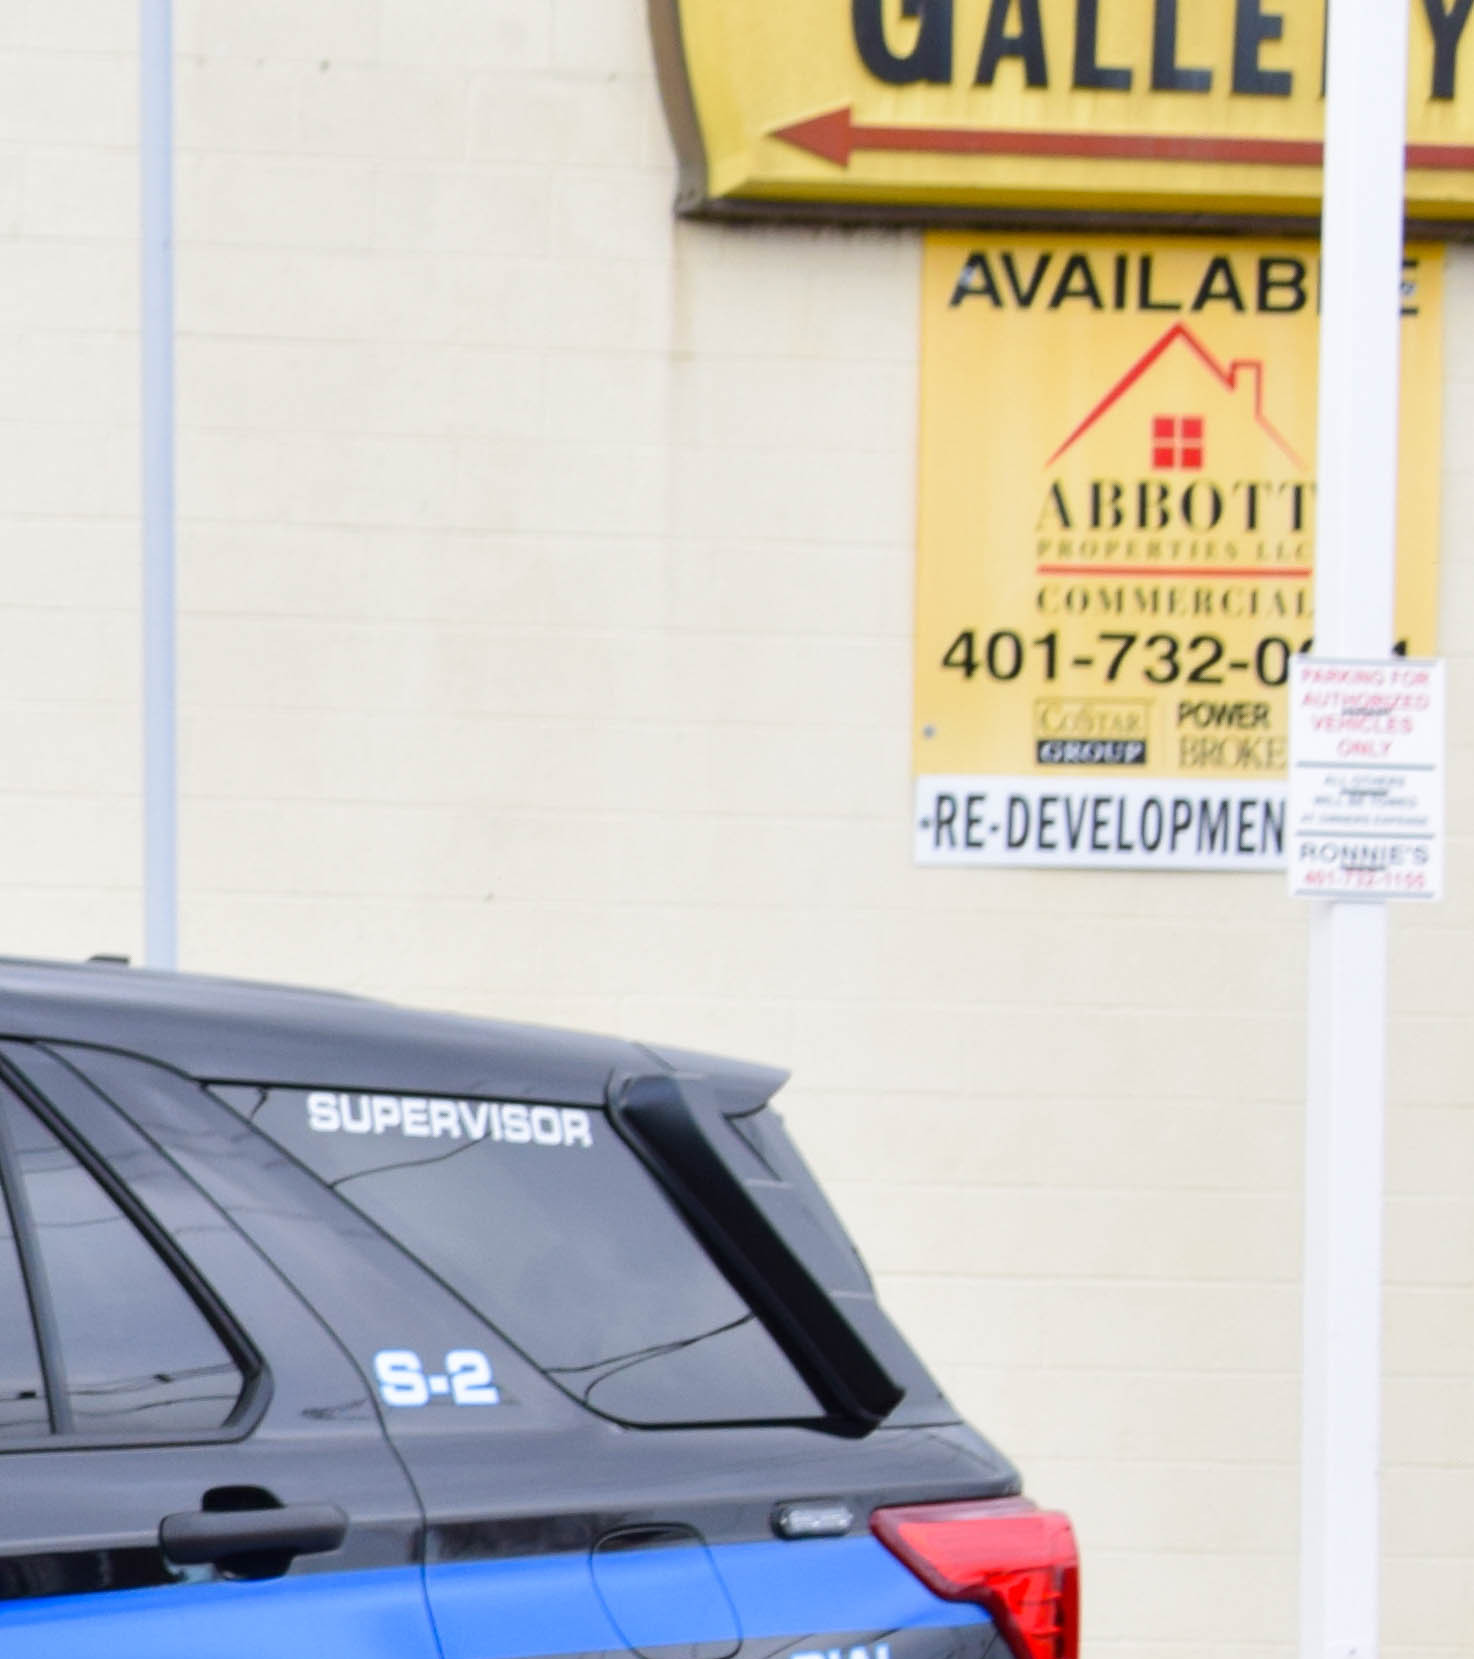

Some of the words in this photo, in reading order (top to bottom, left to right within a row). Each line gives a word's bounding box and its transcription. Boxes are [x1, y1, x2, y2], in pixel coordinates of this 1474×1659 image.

[852, 0, 1474, 101] GALLEY
[948, 252, 1418, 316] AVAILAB
[1035, 479, 1316, 532] ABBOTT
[1037, 539, 1239, 560] PROPERTIES
[1036, 586, 1314, 618] COMMERCIAL
[941, 628, 1407, 686] 401-732-0
[1176, 701, 1270, 729] POWER
[1314, 714, 1413, 734] VEHICLES
[1180, 736, 1287, 769] BROKE
[1337, 739, 1392, 758] ONLY
[933, 793, 1286, 854] RE-DEVELOPMEN
[1299, 842, 1429, 866] RONNIE'S
[307, 1091, 593, 1148] SUPERVISOR
[375, 1349, 498, 1406] S-2
